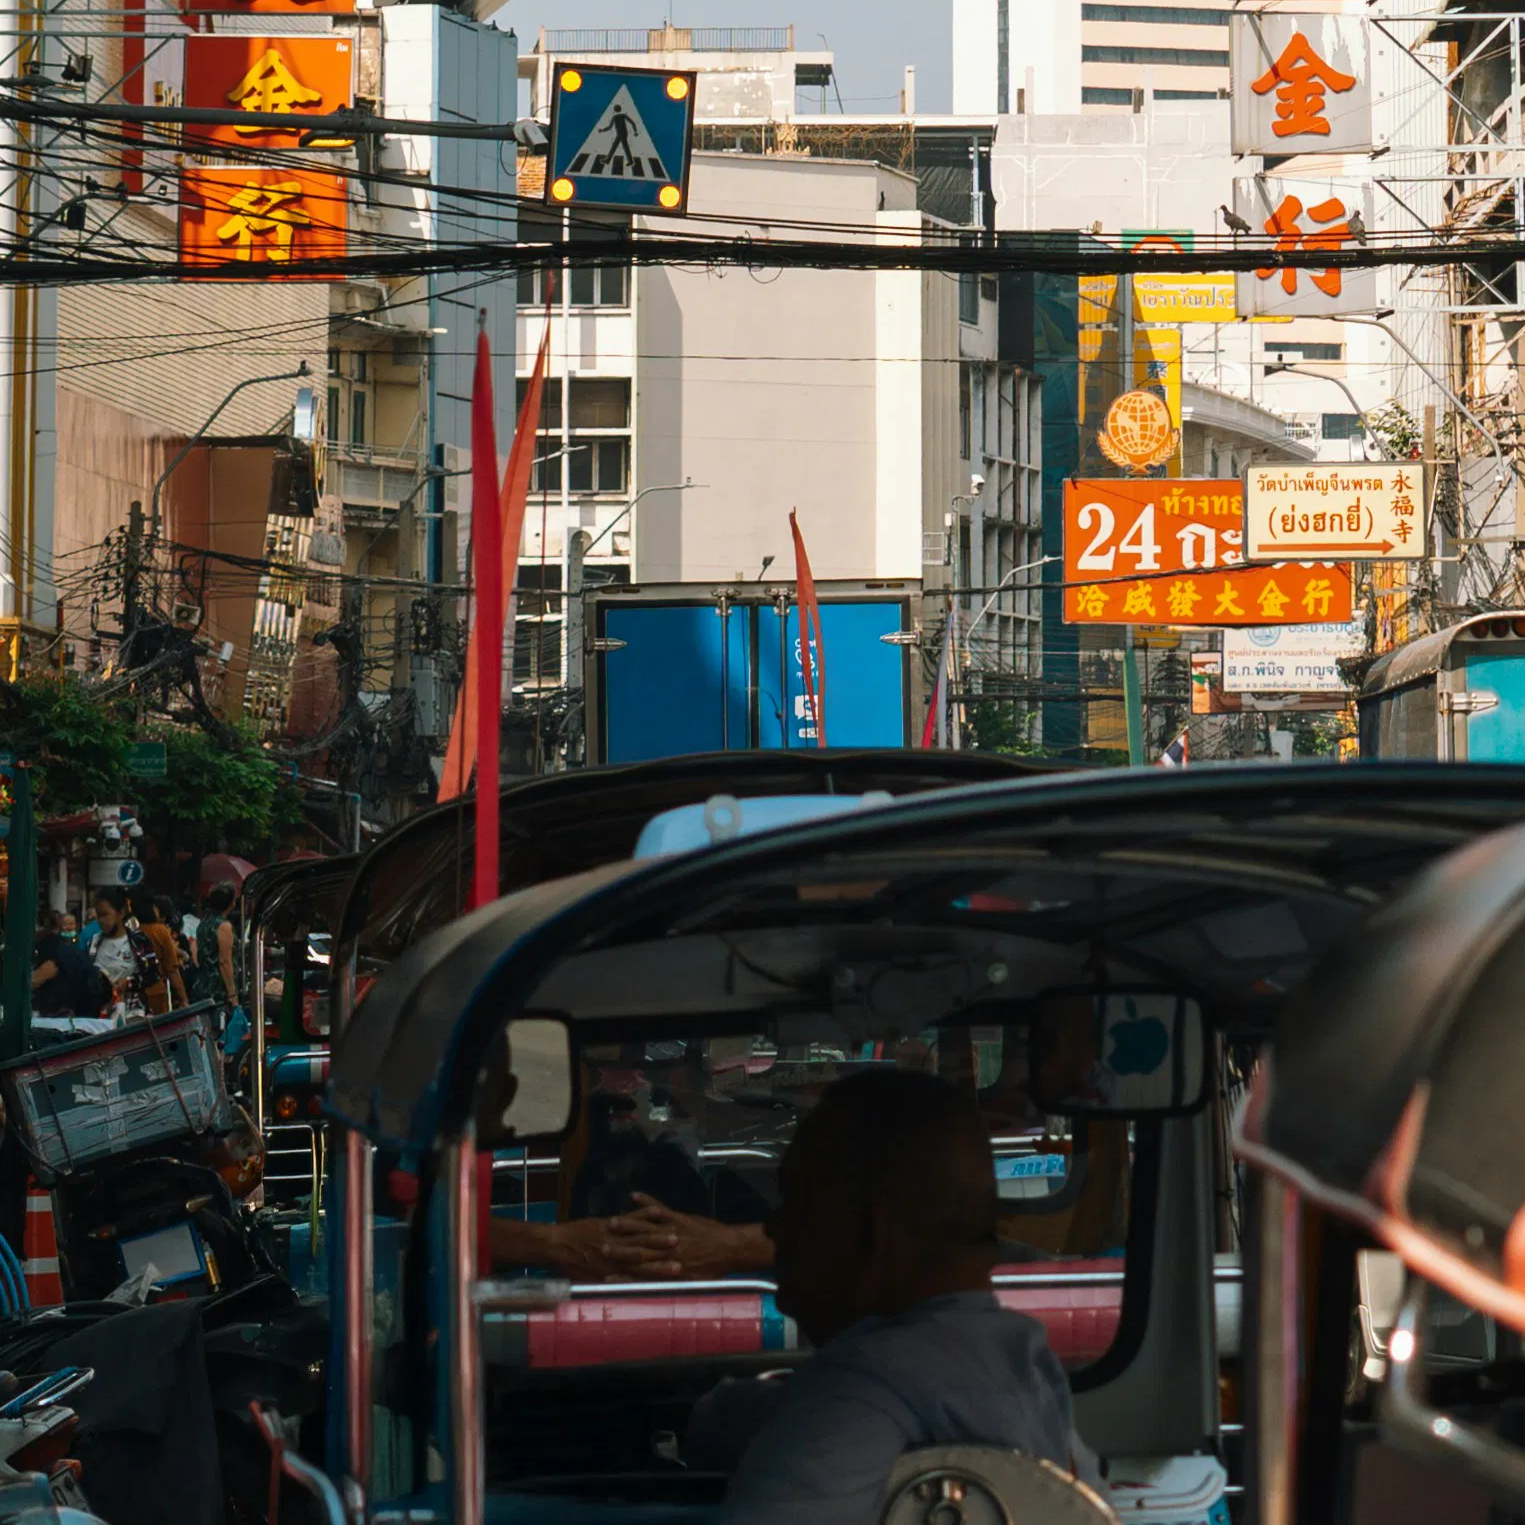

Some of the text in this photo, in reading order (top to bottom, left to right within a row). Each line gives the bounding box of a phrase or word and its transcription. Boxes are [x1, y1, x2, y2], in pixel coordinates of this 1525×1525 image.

[1161, 487, 1243, 516] ห้างทอ
[1257, 471, 1383, 496] วัดบำเพ็ญจีนพรต
[1390, 469, 1415, 544] 永福寺
[1077, 502, 1162, 571] 24
